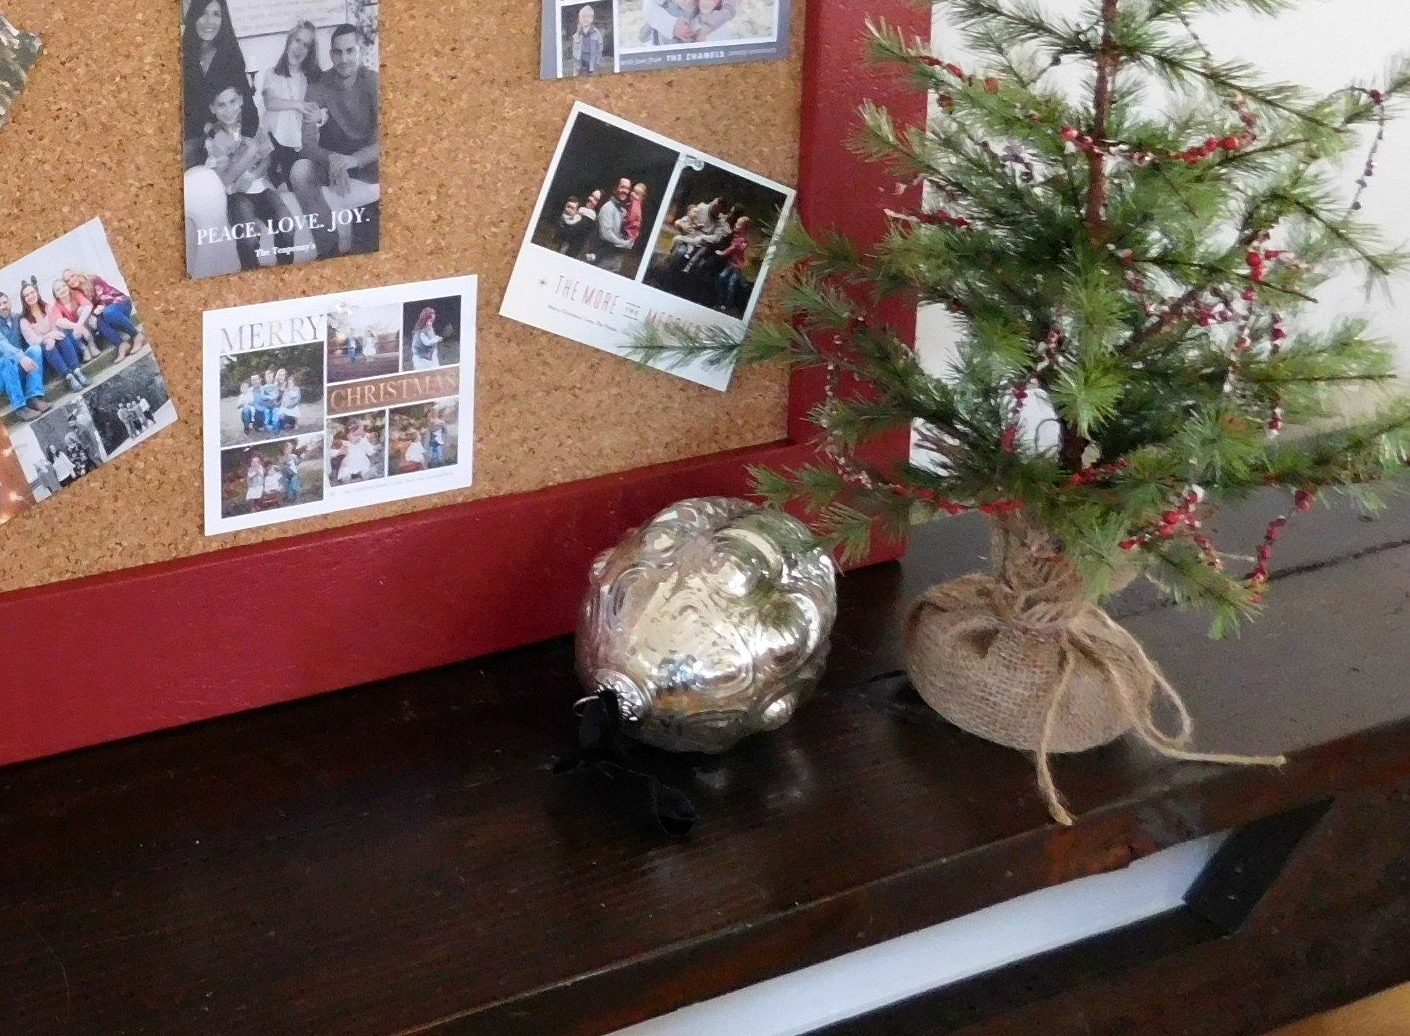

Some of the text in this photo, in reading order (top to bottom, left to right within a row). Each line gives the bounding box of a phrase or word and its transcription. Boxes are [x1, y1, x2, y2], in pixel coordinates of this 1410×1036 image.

[196, 207, 371, 246] PEACE. LOVE. JOY.
[554, 274, 581, 302] THE
[582, 285, 620, 315] MORE
[219, 313, 325, 354] MERRY
[330, 372, 456, 411] CHRISTMAS
